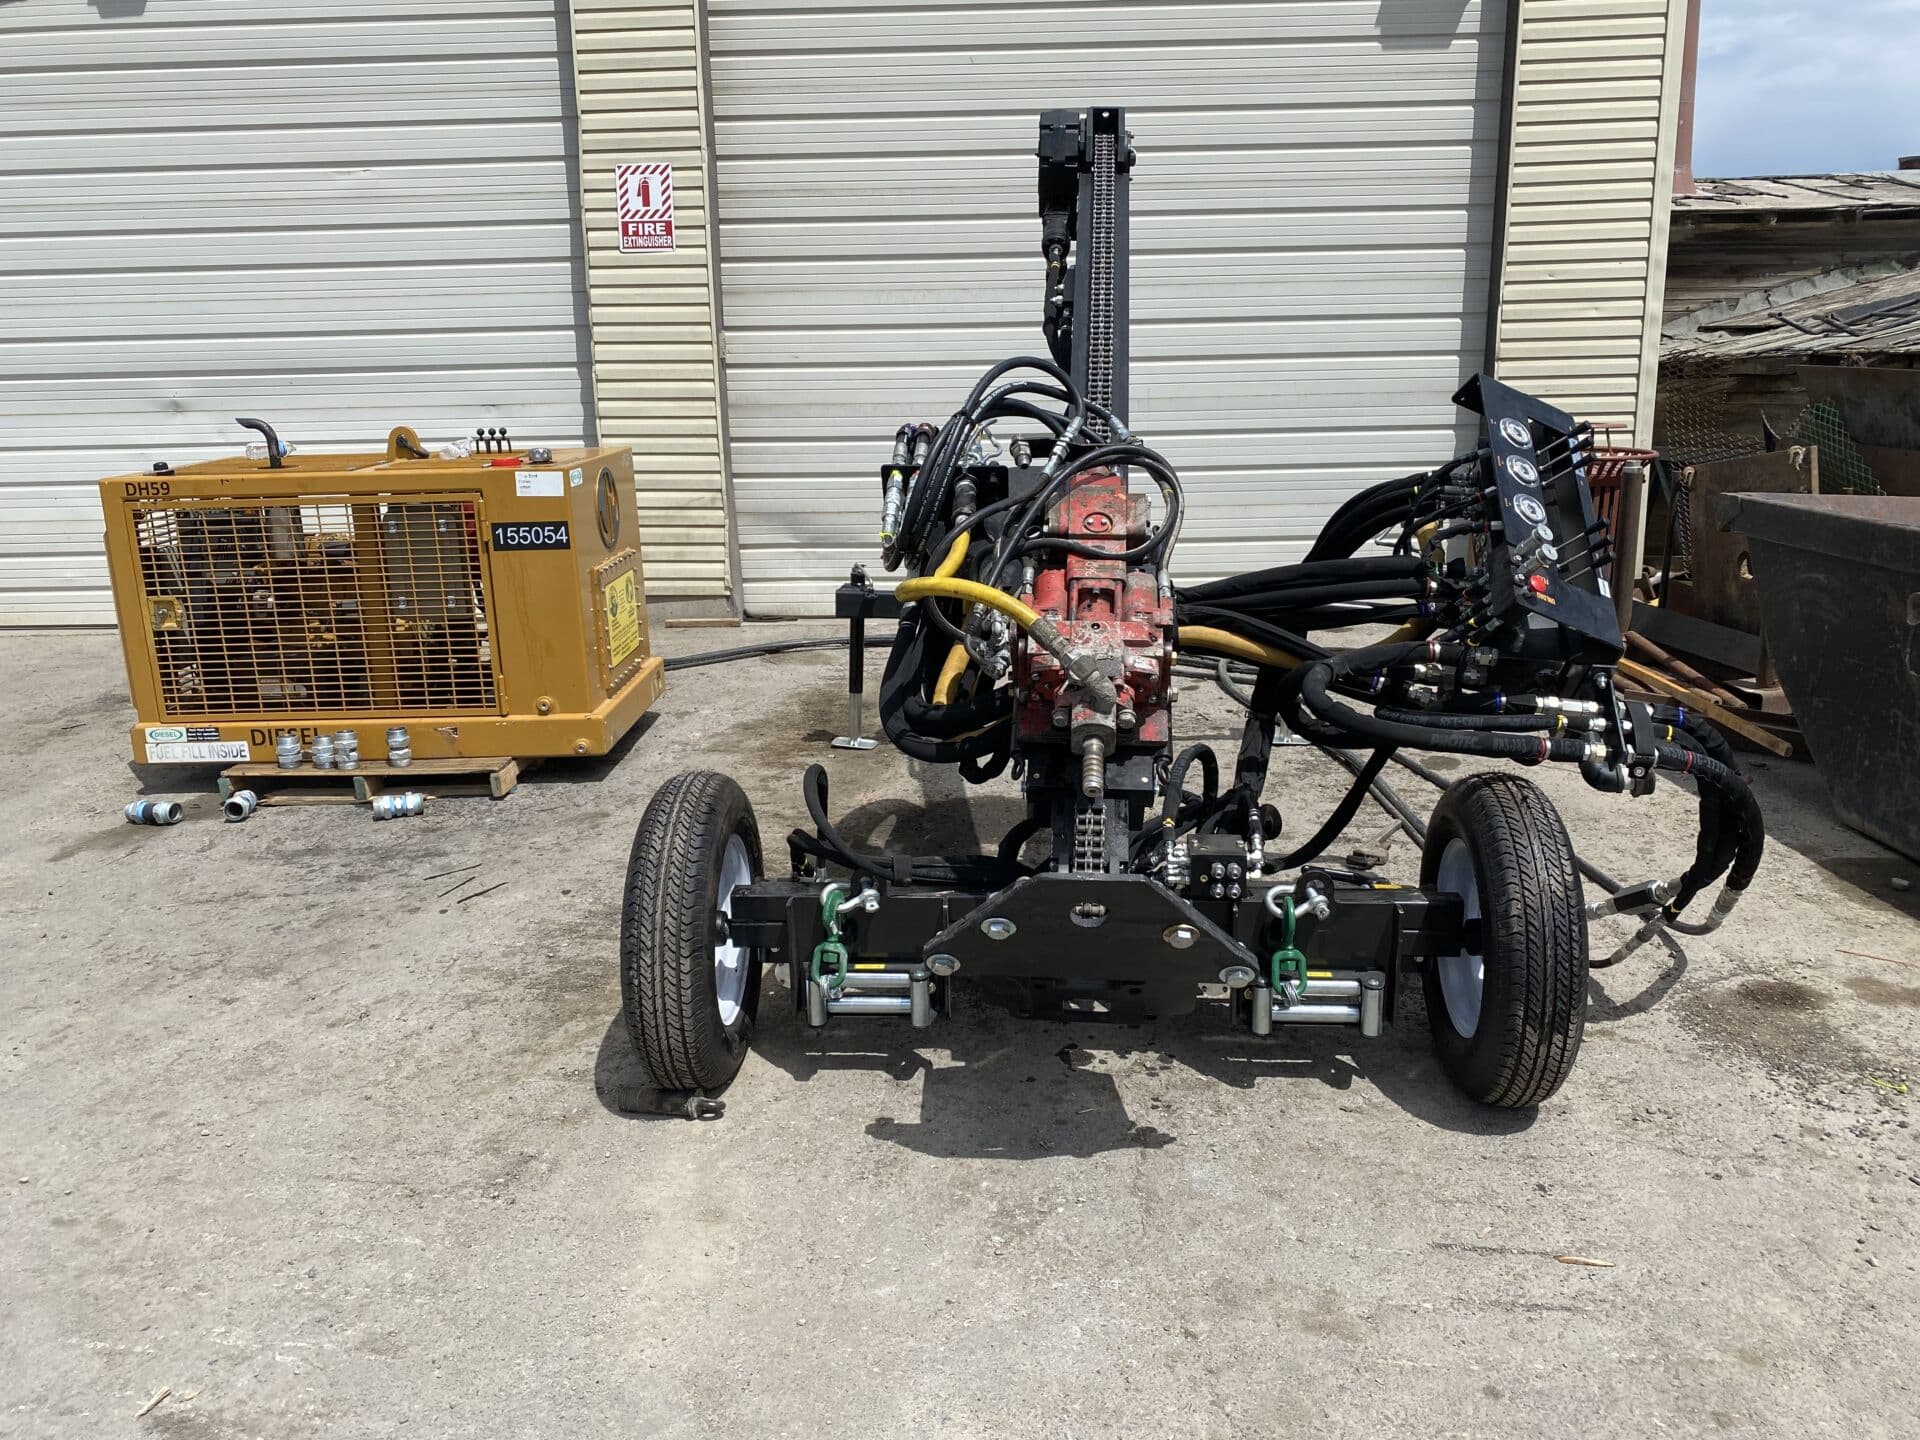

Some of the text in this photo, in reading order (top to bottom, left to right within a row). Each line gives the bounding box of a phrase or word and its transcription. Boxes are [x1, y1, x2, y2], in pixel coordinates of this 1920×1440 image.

[628, 222, 667, 236] FIRE
[623, 235, 672, 248] EXTINGUISHER
[125, 481, 170, 497] DH59
[495, 526, 568, 545] 155054
[154, 730, 178, 738] DIESEL
[149, 743, 248, 760] FUEL FILL INSIDE
